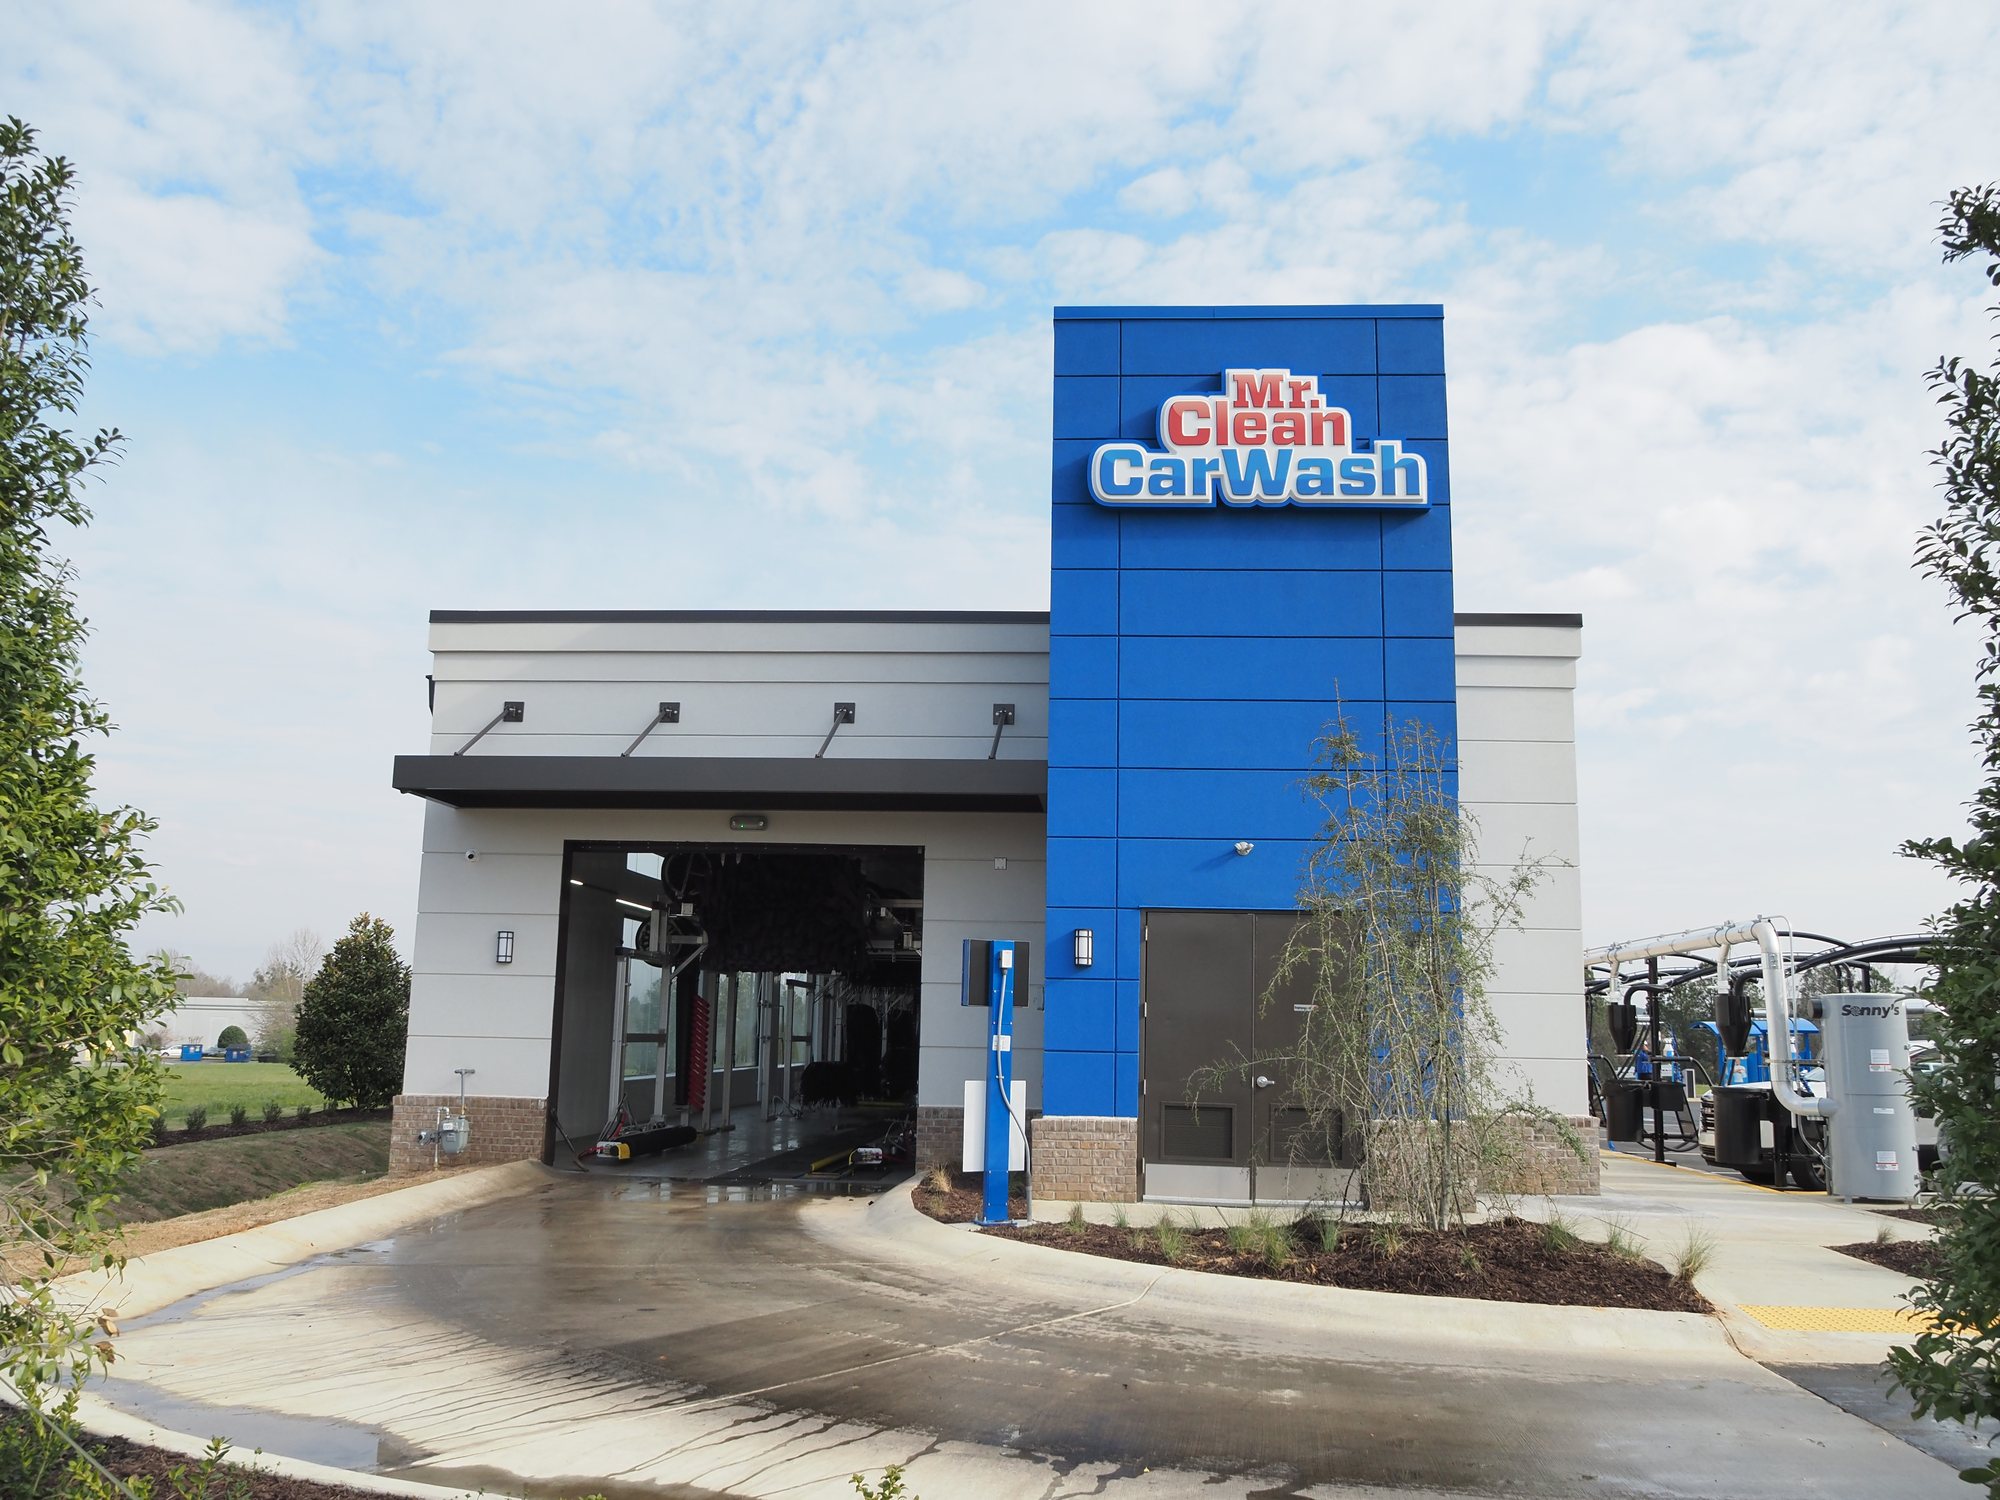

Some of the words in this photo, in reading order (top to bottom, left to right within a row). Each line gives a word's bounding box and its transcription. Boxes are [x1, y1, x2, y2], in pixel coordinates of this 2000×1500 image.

[1232, 373, 1320, 408] Mr.
[1167, 400, 1346, 446] Clean
[1841, 1004, 1900, 1019] Sonny's
